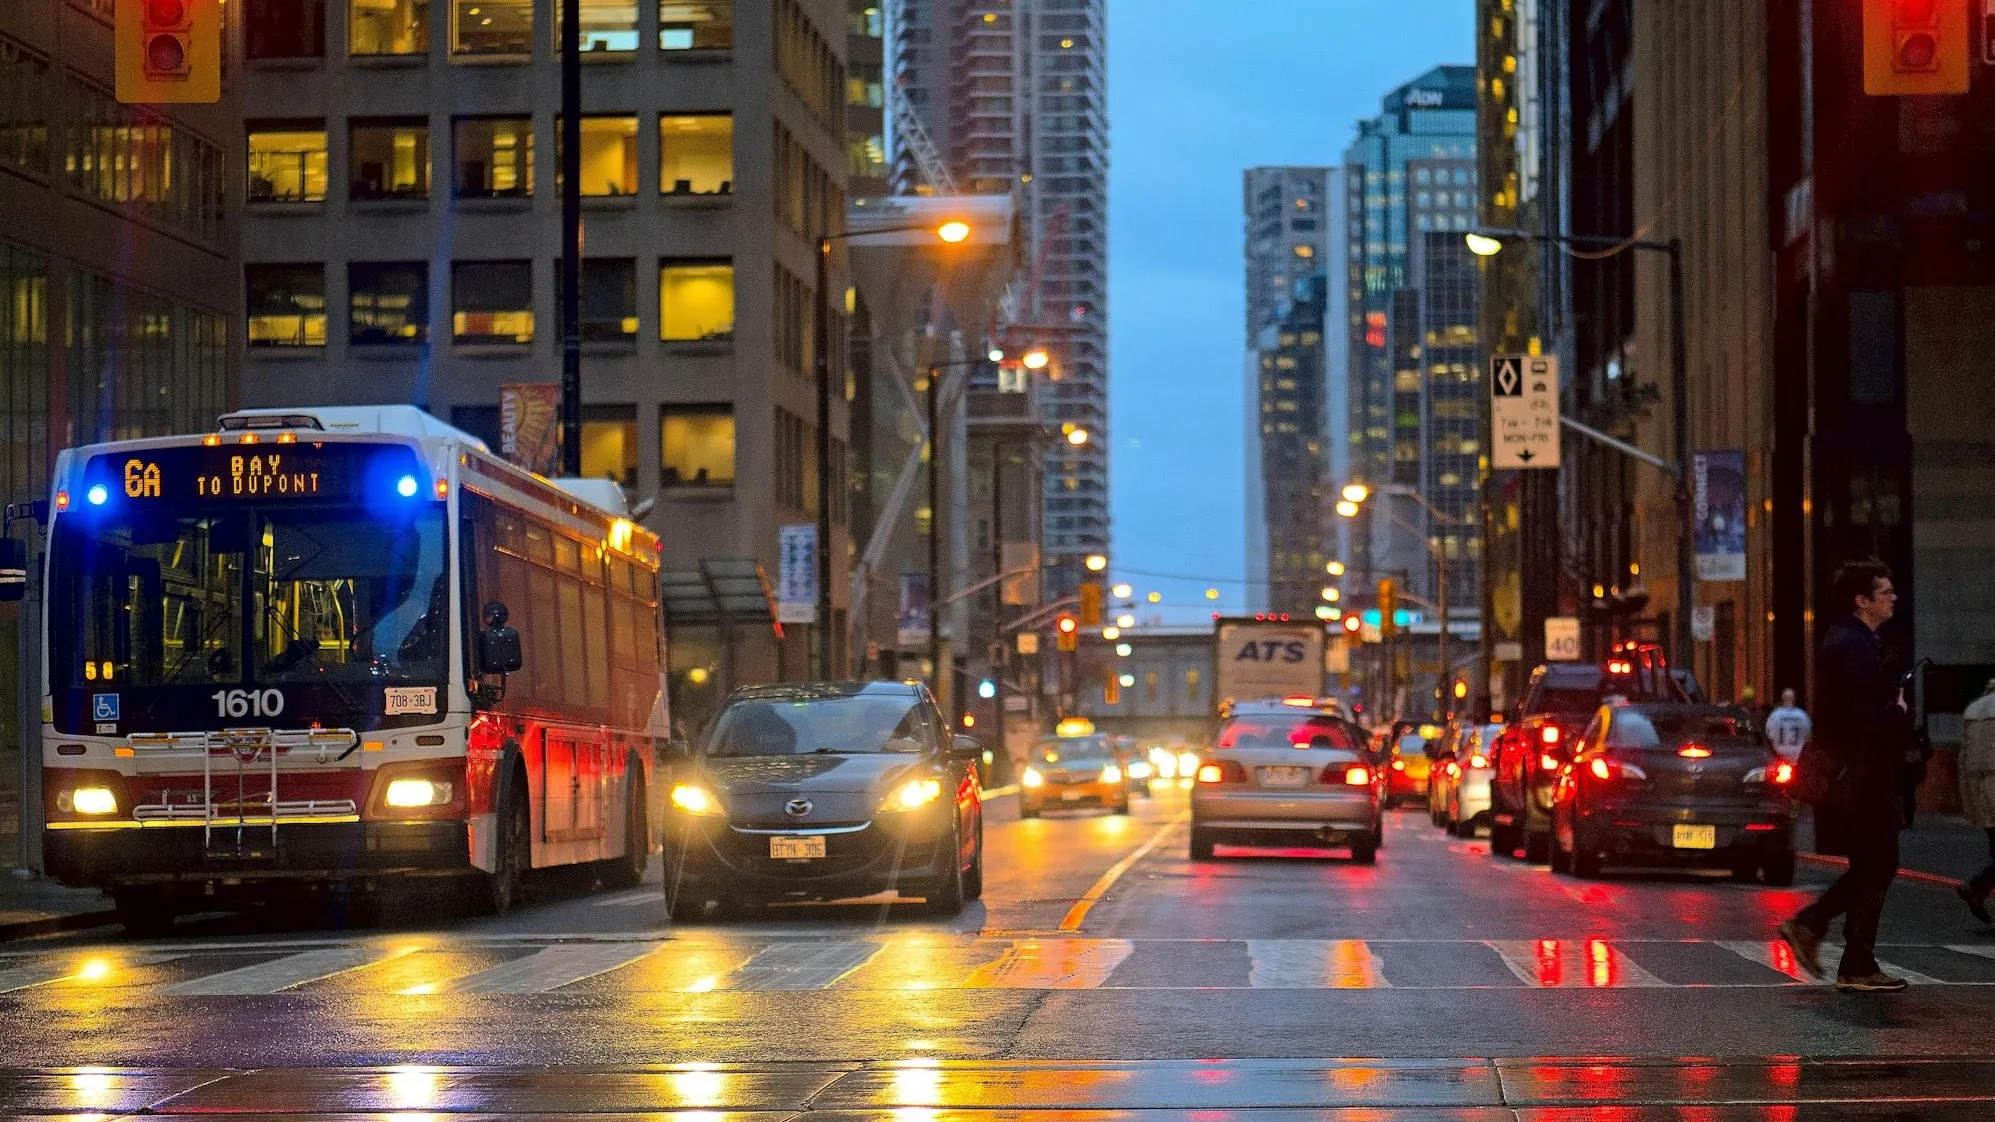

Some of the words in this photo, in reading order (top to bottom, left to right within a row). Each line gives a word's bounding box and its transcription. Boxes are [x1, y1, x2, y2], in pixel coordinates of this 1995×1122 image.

[502, 391, 516, 453] BEAUTY
[124, 459, 161, 498] 6A
[231, 454, 281, 477] BAY
[198, 476, 221, 496] TO
[233, 473, 319, 495] DUPONT
[1236, 641, 1305, 664] ATS
[211, 688, 285, 718] 1610
